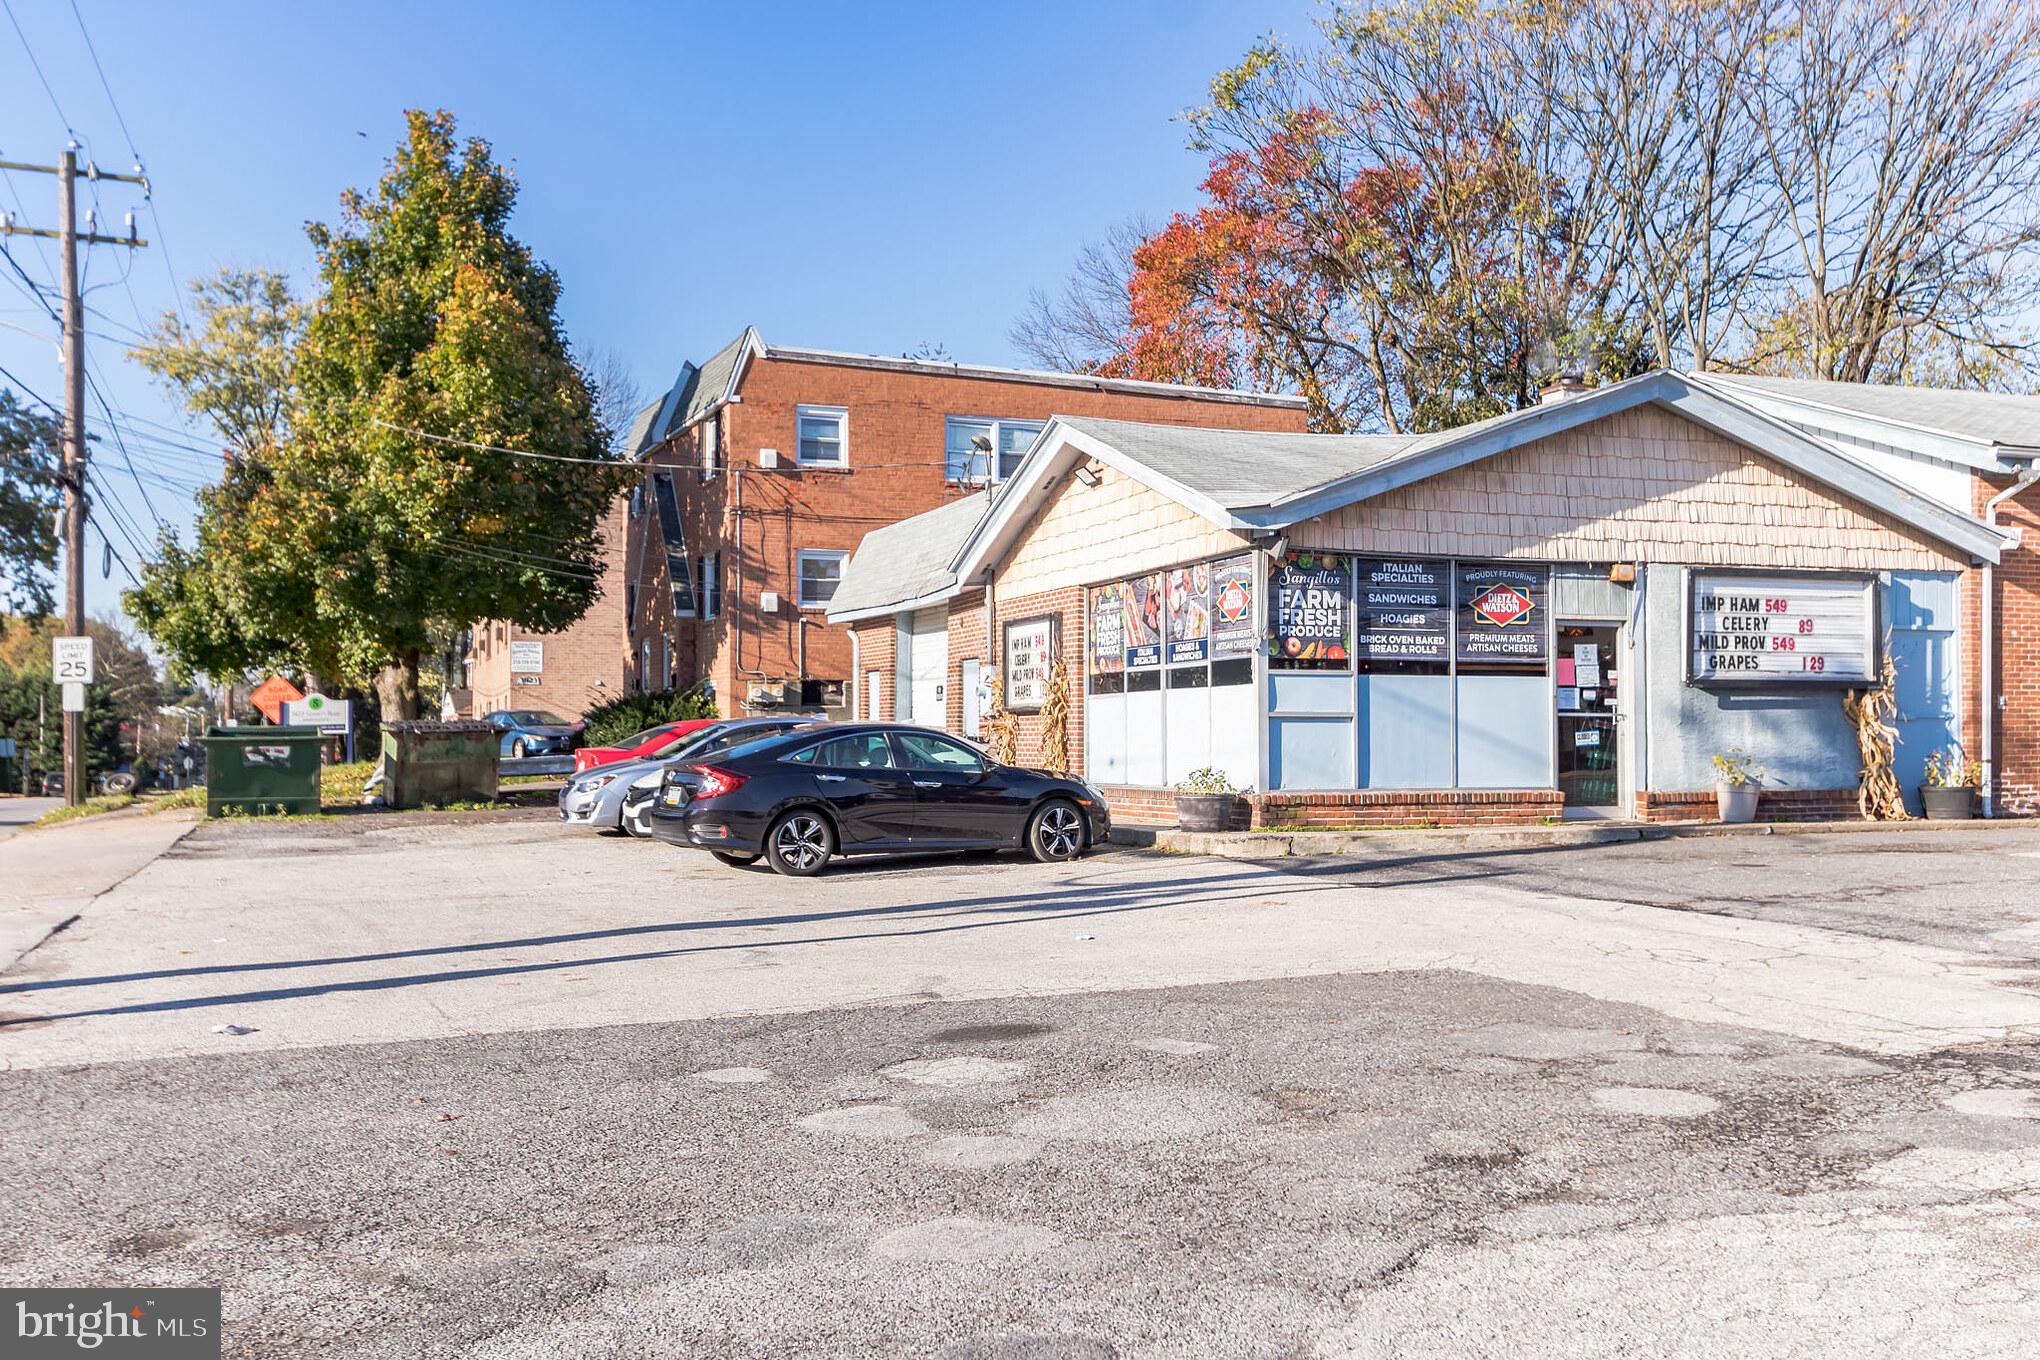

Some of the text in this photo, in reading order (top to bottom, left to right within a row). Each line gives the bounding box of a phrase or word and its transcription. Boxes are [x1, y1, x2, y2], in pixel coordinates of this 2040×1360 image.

[1383, 563, 1423, 573] ITALIAN
[1279, 565, 1341, 589] Sangillo's
[1371, 572, 1434, 584] SPECIALTIES
[1465, 570, 1537, 583] PROUDLY FEATURING
[1279, 589, 1341, 609] FARM
[1368, 593, 1437, 605] SANDWICHES
[1488, 593, 1512, 604] DIETZ
[1482, 602, 1520, 613] WATSON
[1701, 597, 1788, 613] IMP HAM 549
[1096, 612, 1120, 632] FARM
[1279, 608, 1341, 626] FRESH
[1380, 613, 1426, 624] HOAGIES
[1722, 616, 1814, 633] CELERY 89
[1279, 625, 1341, 637] PRODUCE
[1096, 630, 1120, 648] FRESH
[1360, 635, 1446, 645] BRICK OVEN BAKED
[1469, 633, 1535, 643] PREMIUM MEATS
[1699, 635, 1796, 651] MILD PROV 549
[60, 642, 88, 650] SPEED
[1011, 639, 1020, 651] IMP
[1368, 644, 1438, 654] BREAD & ROLLS
[1466, 643, 1538, 653] ARTISAN CHEESES
[62, 651, 84, 659] LIMIT
[60, 661, 87, 677] 25
[1709, 655, 1825, 671] GRAPES 129
[1014, 684, 1032, 697] GRAPES
